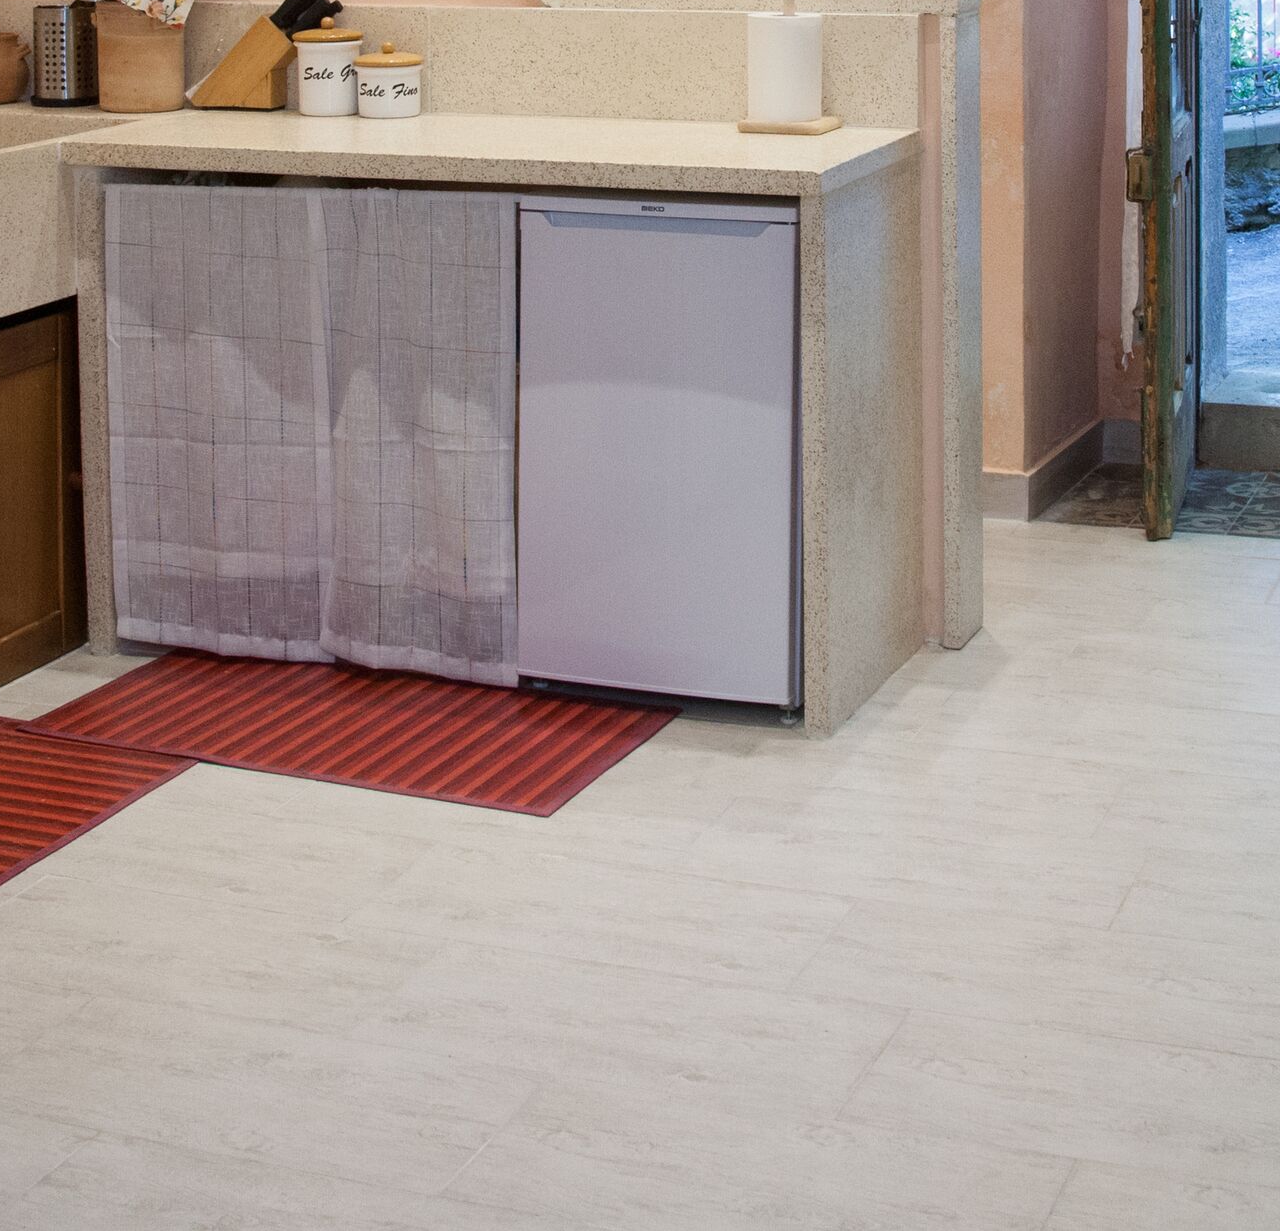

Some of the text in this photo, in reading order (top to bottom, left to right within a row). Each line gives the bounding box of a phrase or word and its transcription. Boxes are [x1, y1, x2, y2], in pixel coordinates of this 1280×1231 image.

[303, 67, 334, 80] Sale
[359, 83, 418, 99] Sale Fino
